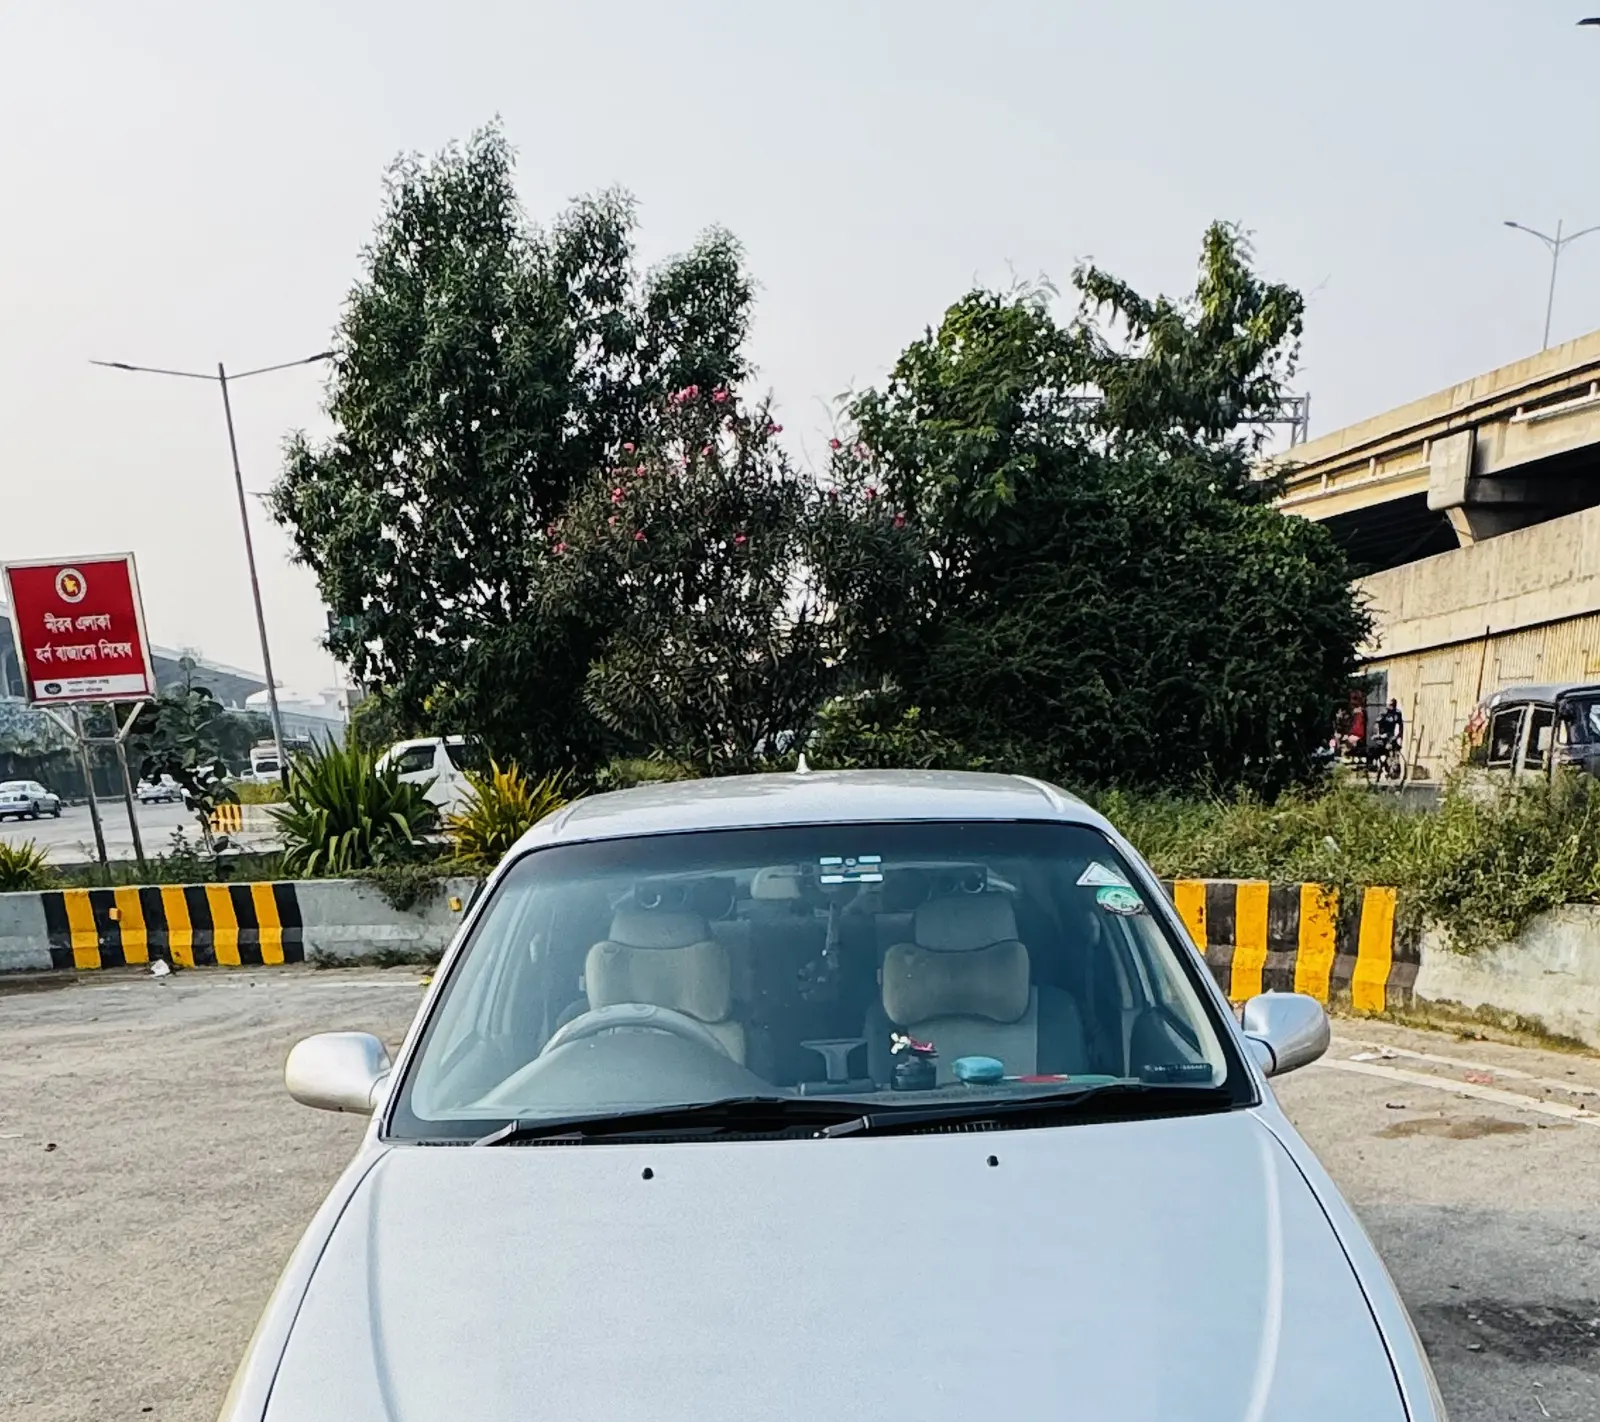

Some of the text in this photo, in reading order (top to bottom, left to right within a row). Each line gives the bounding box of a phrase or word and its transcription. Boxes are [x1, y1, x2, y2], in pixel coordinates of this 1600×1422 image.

[43, 612, 112, 634] নীরব এলাকা
[53, 643, 97, 662] বাজানো
[98, 638, 133, 659] নিষেধ
